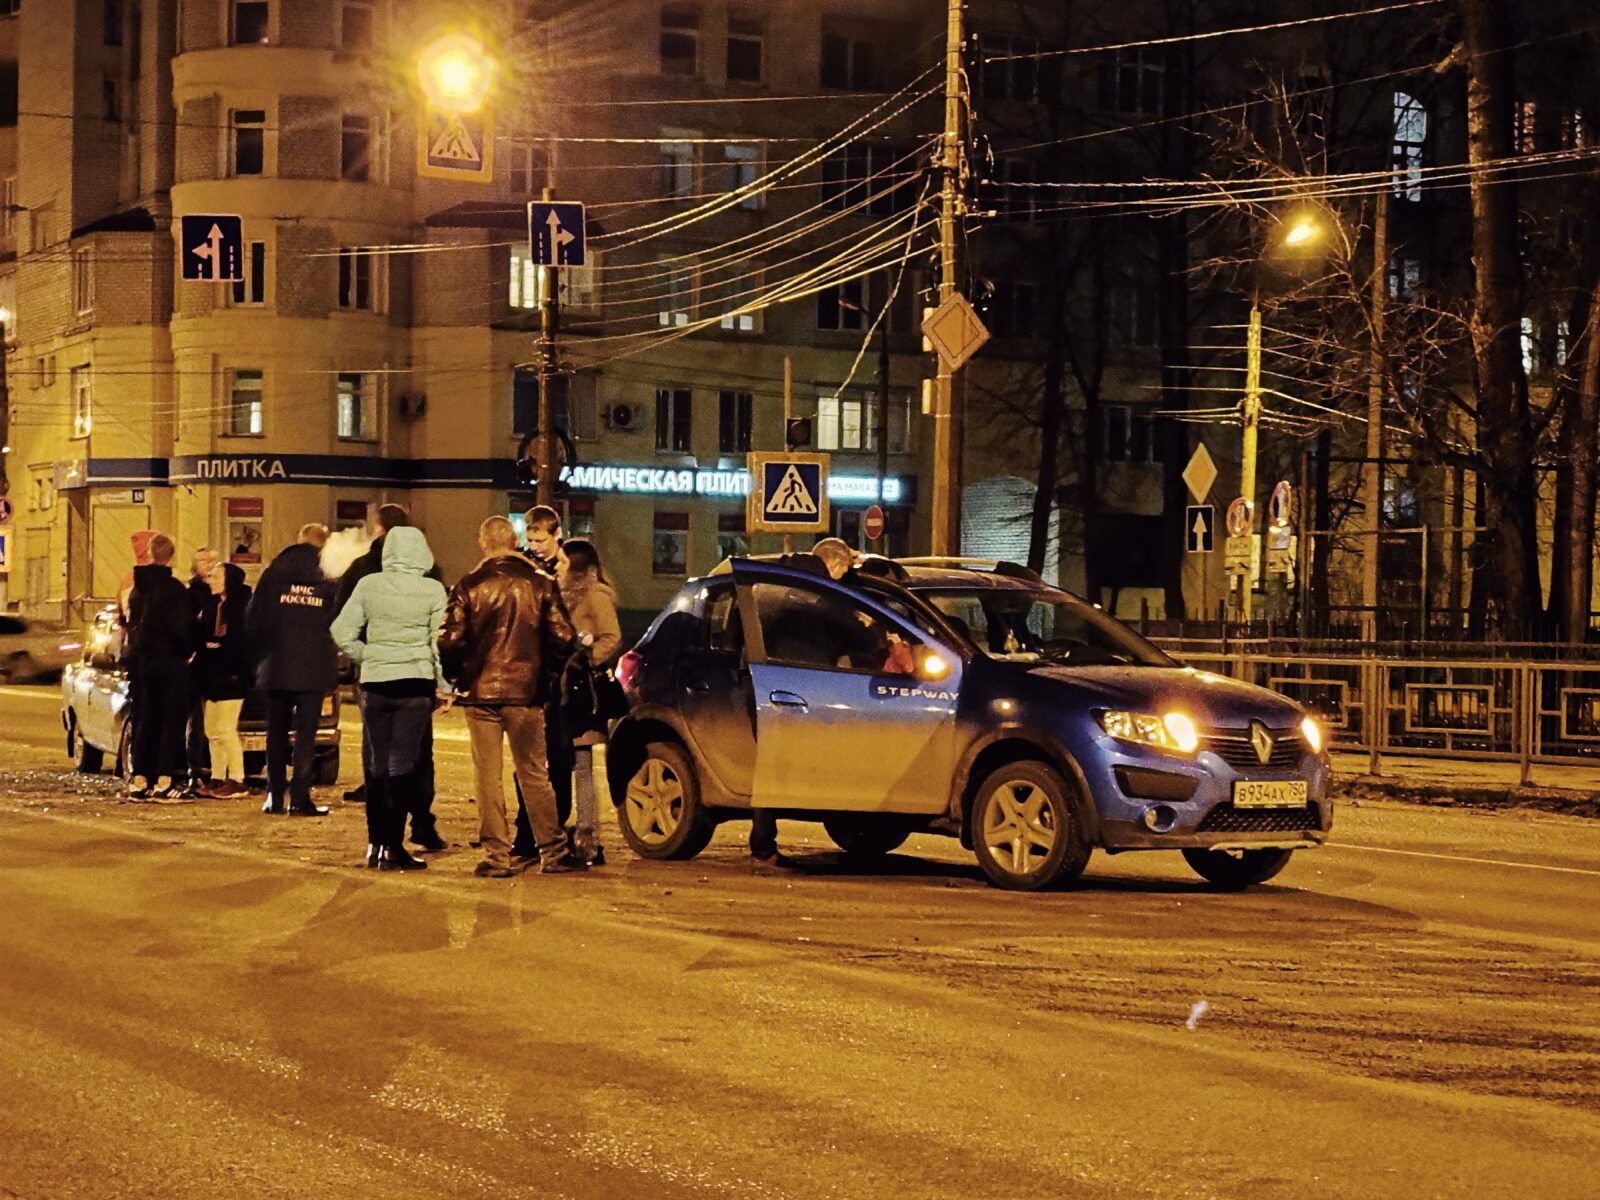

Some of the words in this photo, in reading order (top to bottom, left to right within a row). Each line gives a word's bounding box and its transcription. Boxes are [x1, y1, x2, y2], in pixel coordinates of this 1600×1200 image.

[197, 459, 287, 478] ПЛИТКА
[290, 584, 315, 595] МЧС
[877, 686, 959, 700] STEPWAY
